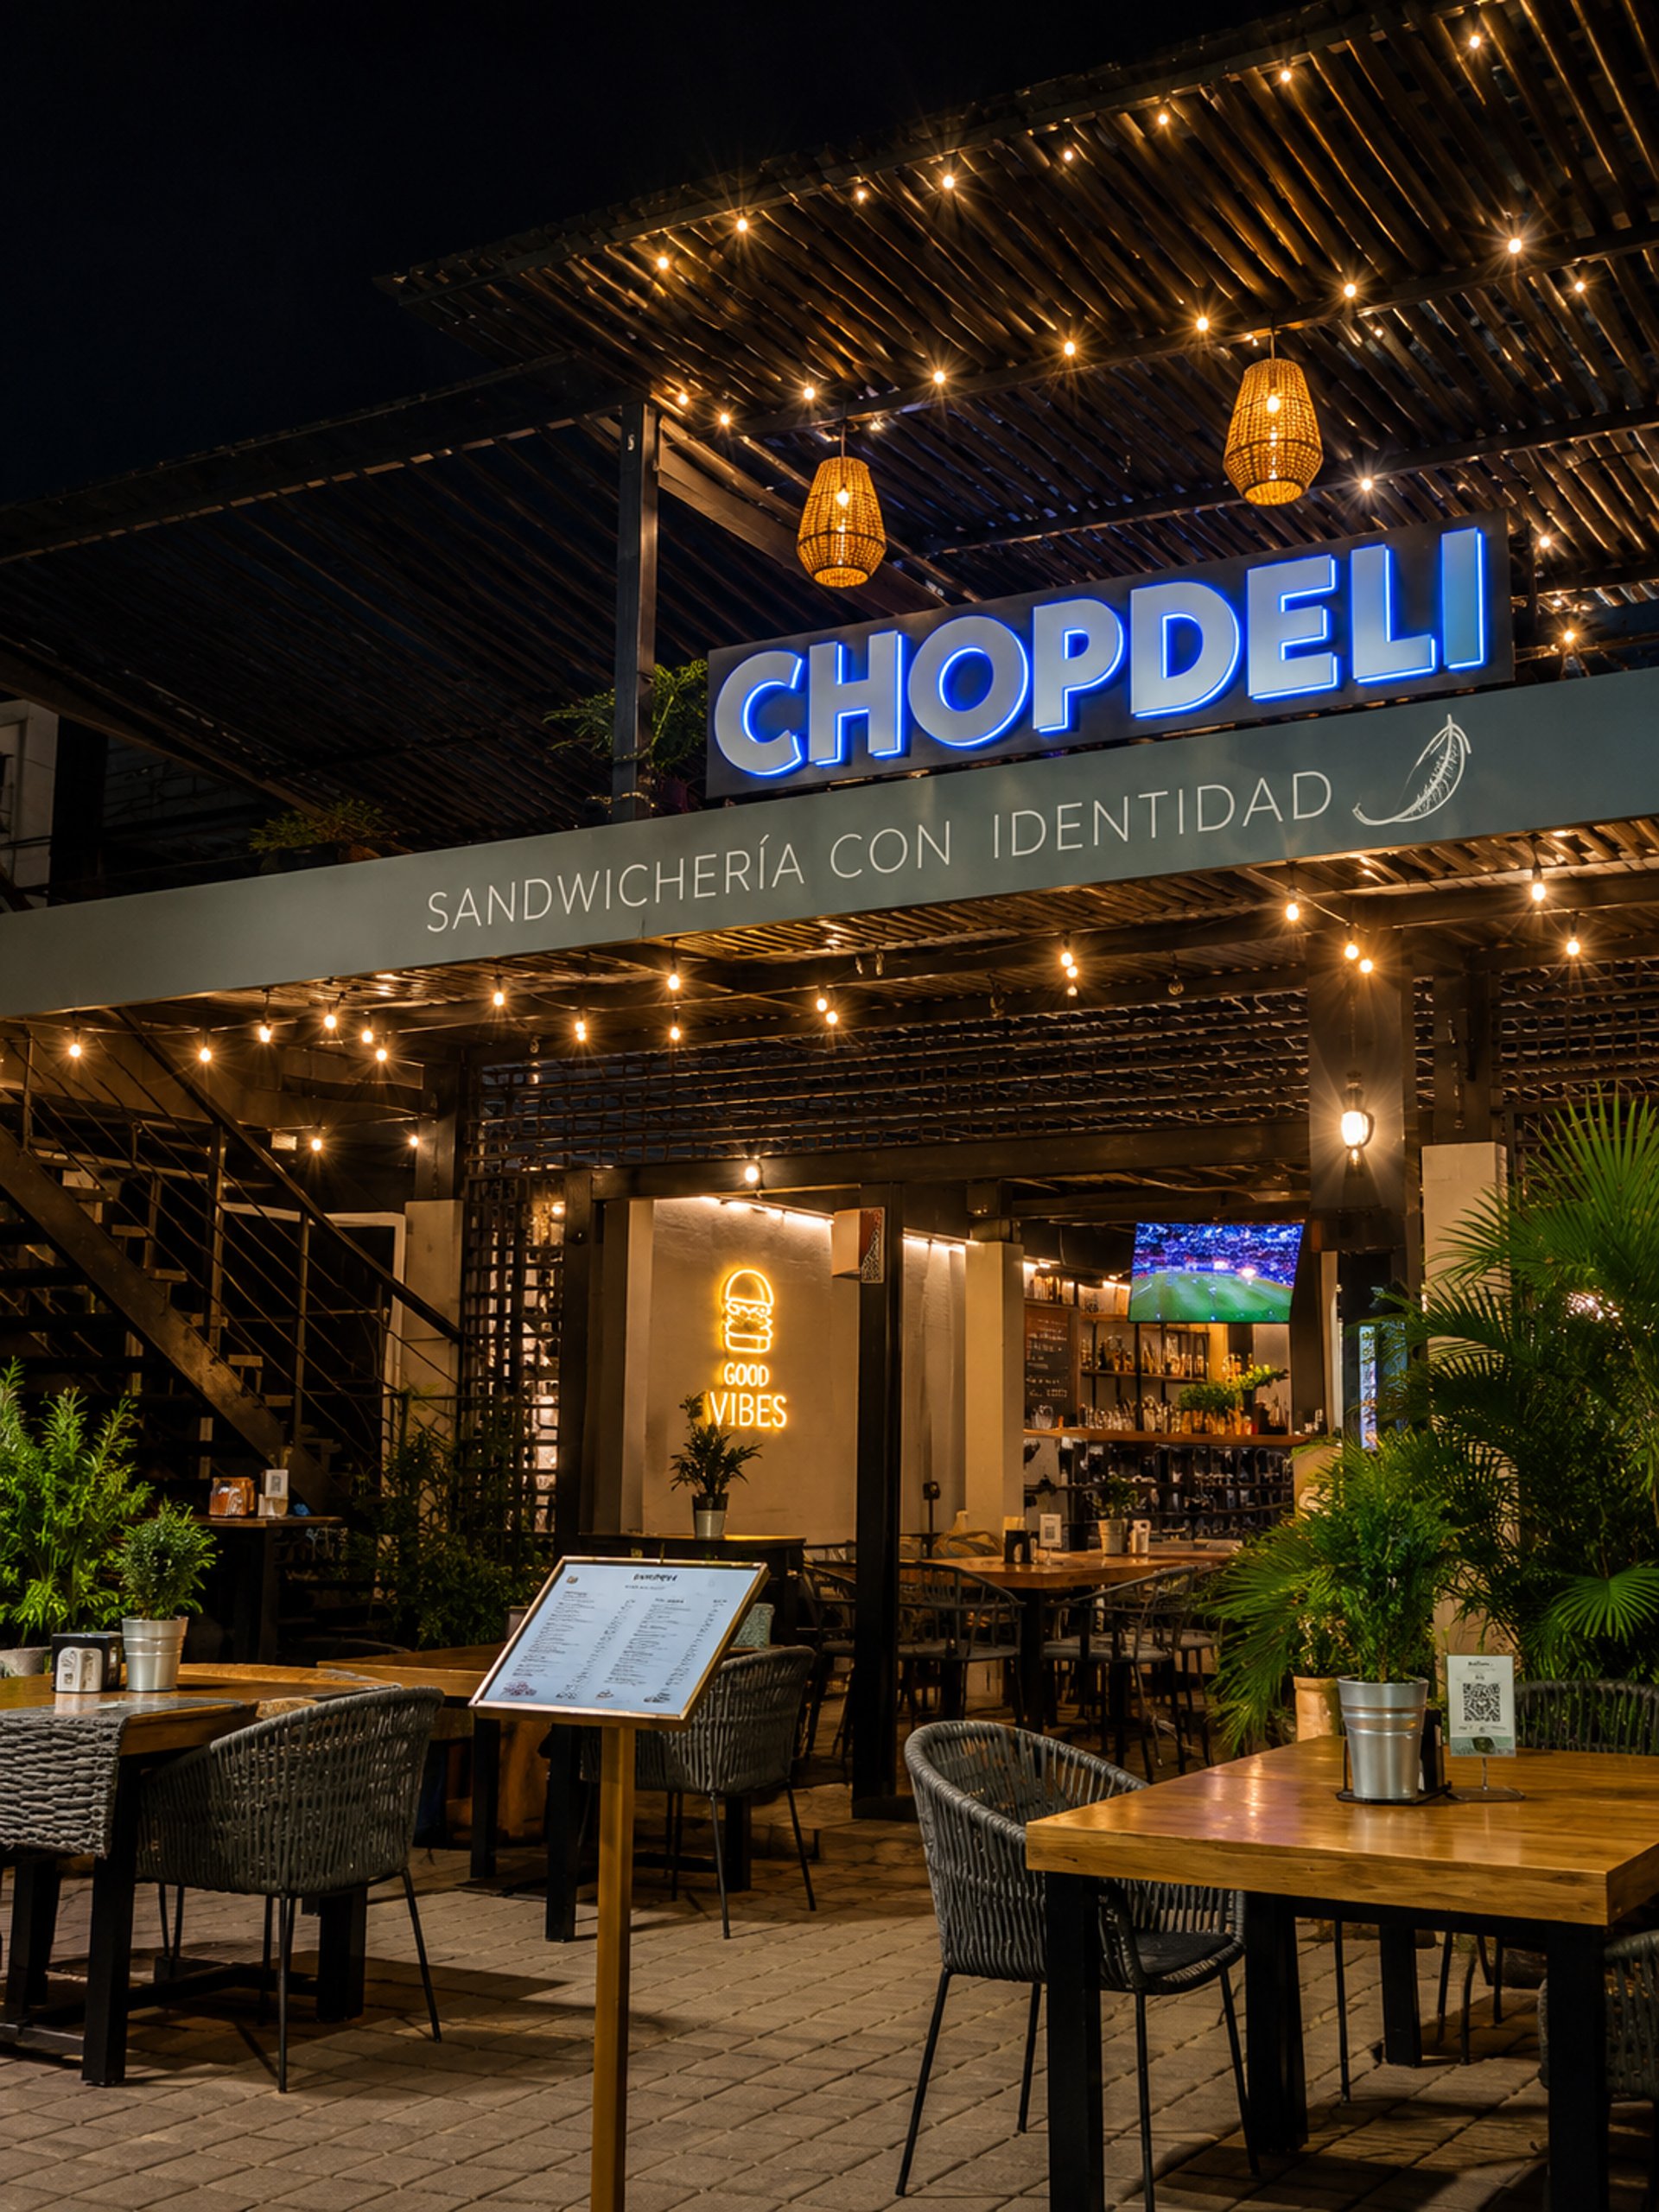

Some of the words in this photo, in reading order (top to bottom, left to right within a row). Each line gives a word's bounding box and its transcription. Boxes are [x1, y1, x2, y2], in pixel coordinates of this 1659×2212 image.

[715, 526, 1484, 777] CHOPDELI
[426, 833, 805, 933] SANDWICHERÍA
[830, 820, 951, 880] CON
[994, 771, 1332, 859] IDENTIDAD
[709, 1390, 787, 1428] VIBES
[723, 1362, 770, 1388] GOOD
